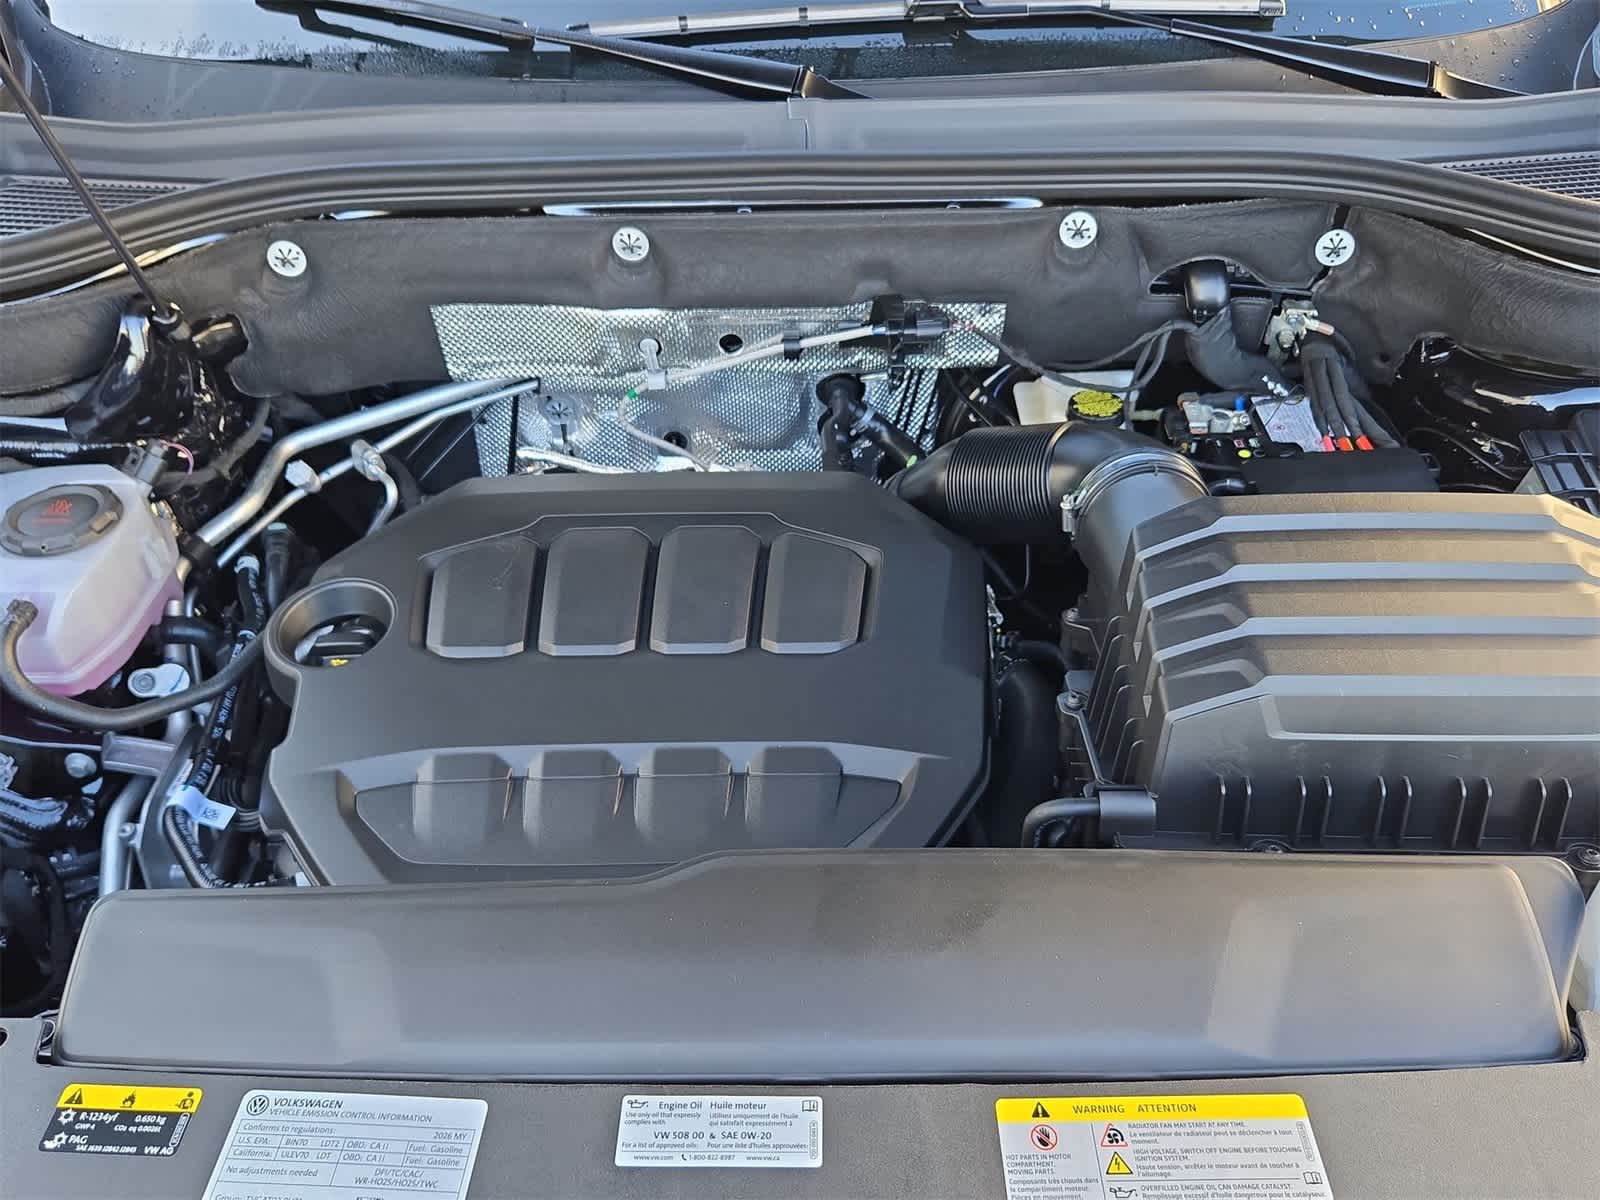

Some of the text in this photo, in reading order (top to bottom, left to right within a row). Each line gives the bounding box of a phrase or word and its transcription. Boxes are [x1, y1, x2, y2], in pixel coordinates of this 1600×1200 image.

[274, 1098, 344, 1109] VOLKSWAGEN
[659, 1101, 703, 1111] Engine Oil
[710, 1102, 767, 1110] Huile moteur
[1137, 1103, 1197, 1114] ATTENTION
[1072, 1104, 1125, 1115] WARNING
[80, 1112, 120, 1124] R-1234yf
[134, 1115, 167, 1125] 0.650 kg
[269, 1108, 433, 1123] VEHICLE EMISSION CONTROL INFORMATION
[673, 1112, 701, 1120] expressly
[244, 1123, 280, 1132] Conforms
[290, 1126, 337, 1135] regulations:
[68, 1135, 89, 1144] PAG
[238, 1136, 271, 1144] U.S. EPA:
[432, 1132, 452, 1140] 2026
[654, 1131, 773, 1140] VW 508 00 & SAE 0W-20
[320, 1140, 340, 1148] LDT2
[408, 1144, 463, 1154] Fuel: Gasoline
[656, 1142, 685, 1150] approved
[144, 1146, 174, 1155] VW AG
[233, 1148, 272, 1157] California:
[281, 1150, 332, 1160] ULEV70 LDT
[405, 1156, 460, 1167] Fuel: Gasoline
[226, 1166, 319, 1177] No adjustments needed
[1009, 1178, 1047, 1186] Composants
